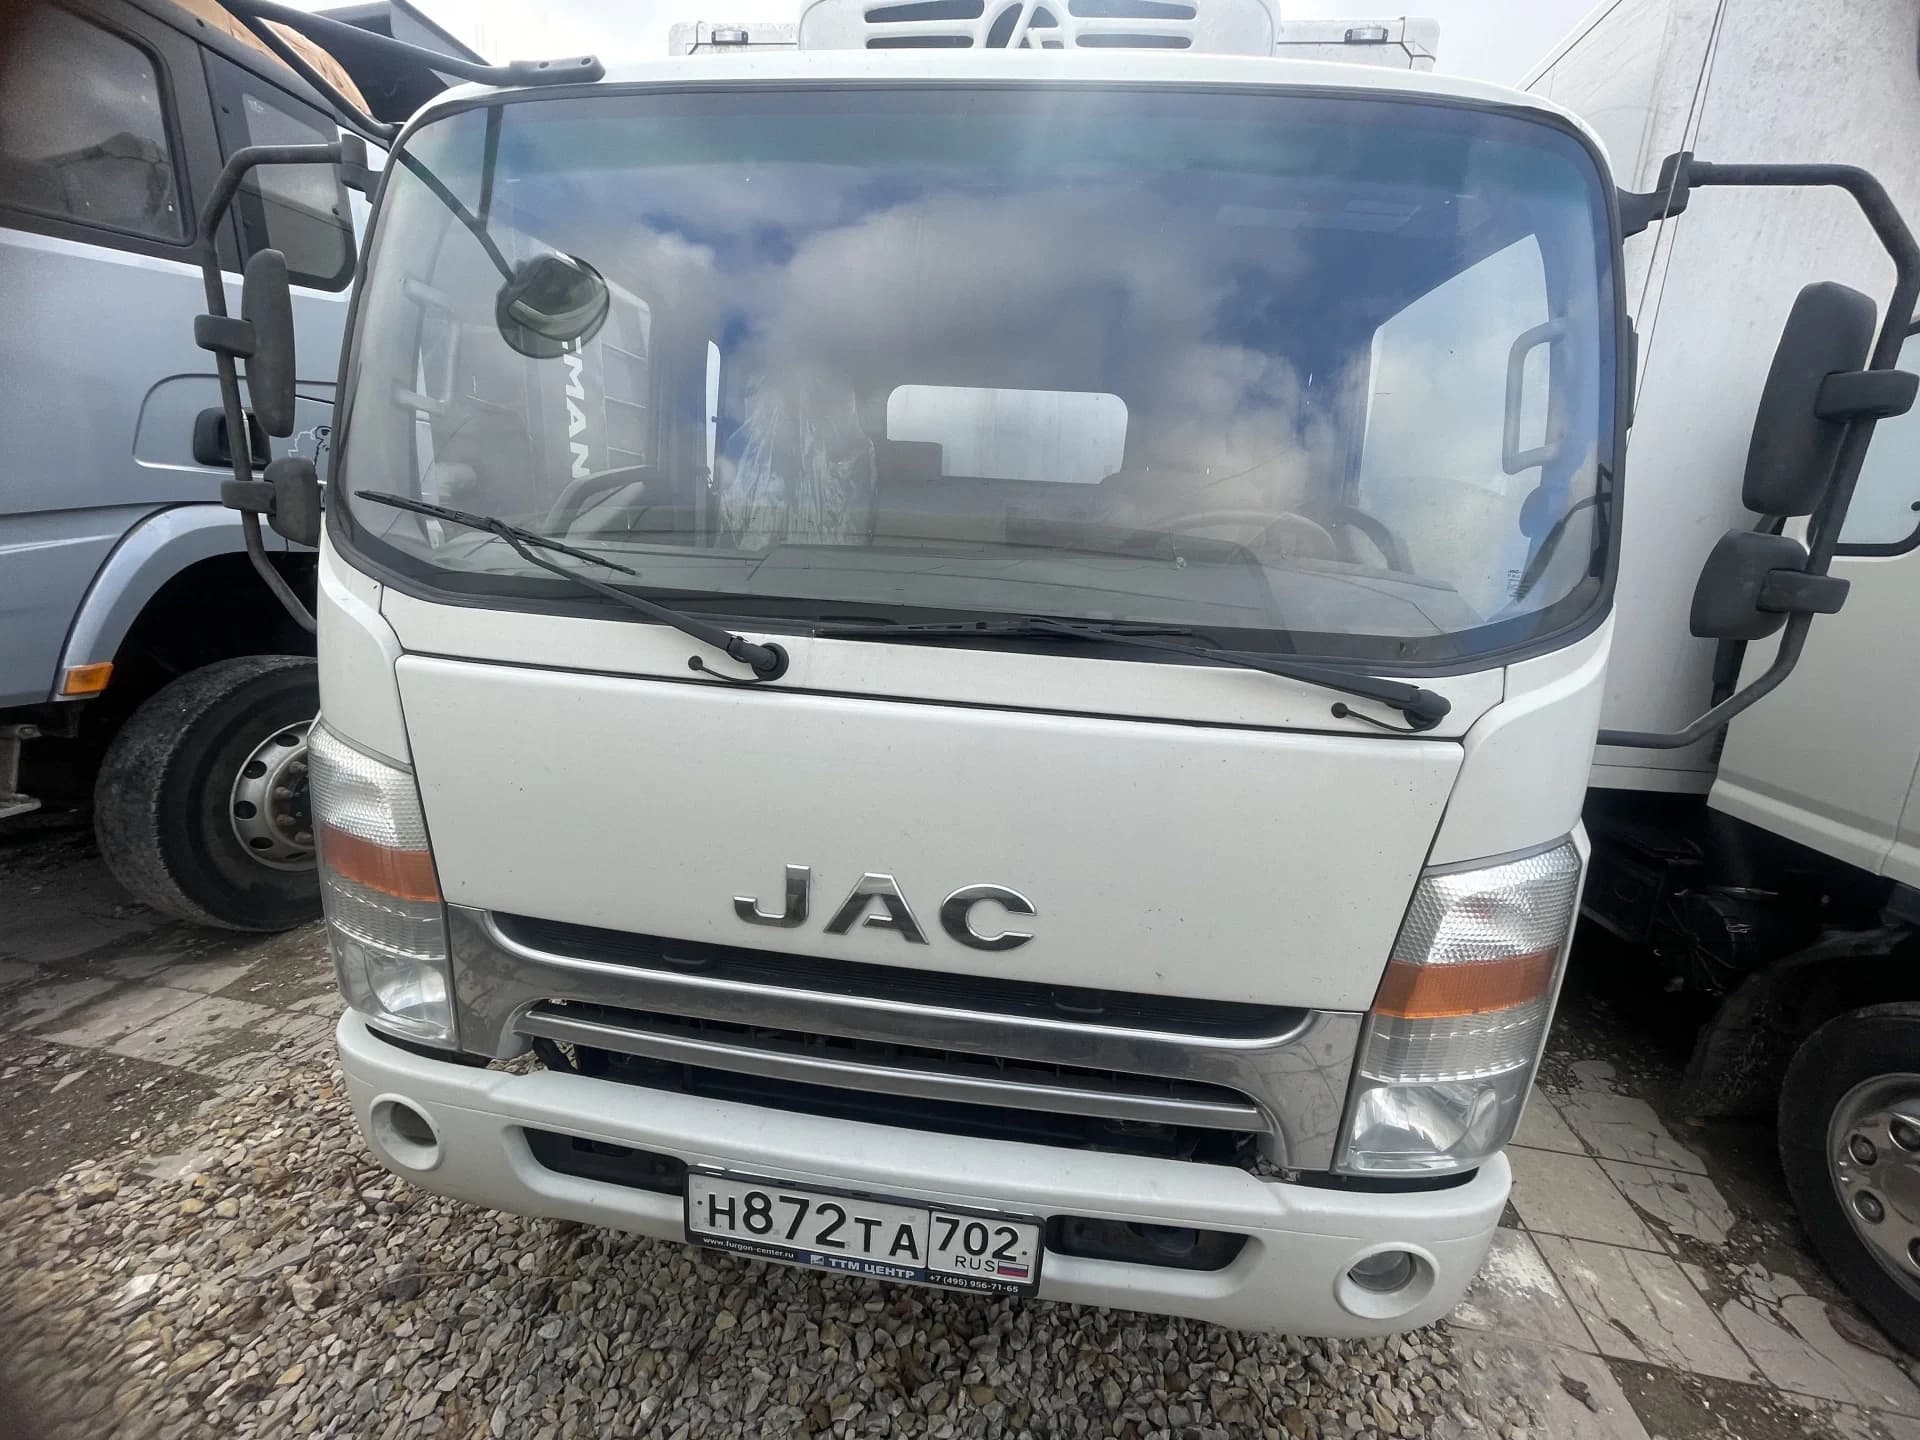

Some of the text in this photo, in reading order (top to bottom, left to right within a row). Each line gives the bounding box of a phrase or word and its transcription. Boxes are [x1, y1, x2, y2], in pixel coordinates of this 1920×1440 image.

[733, 863, 1037, 952] JAC
[703, 1236, 795, 1259] www.furgon-center.ru
[935, 1217, 1019, 1262] 702
[864, 1263, 915, 1280] ЦЕНТР
[954, 1255, 996, 1272] RUS
[929, 1274, 1019, 1293] +7 (495) 956-71-65
